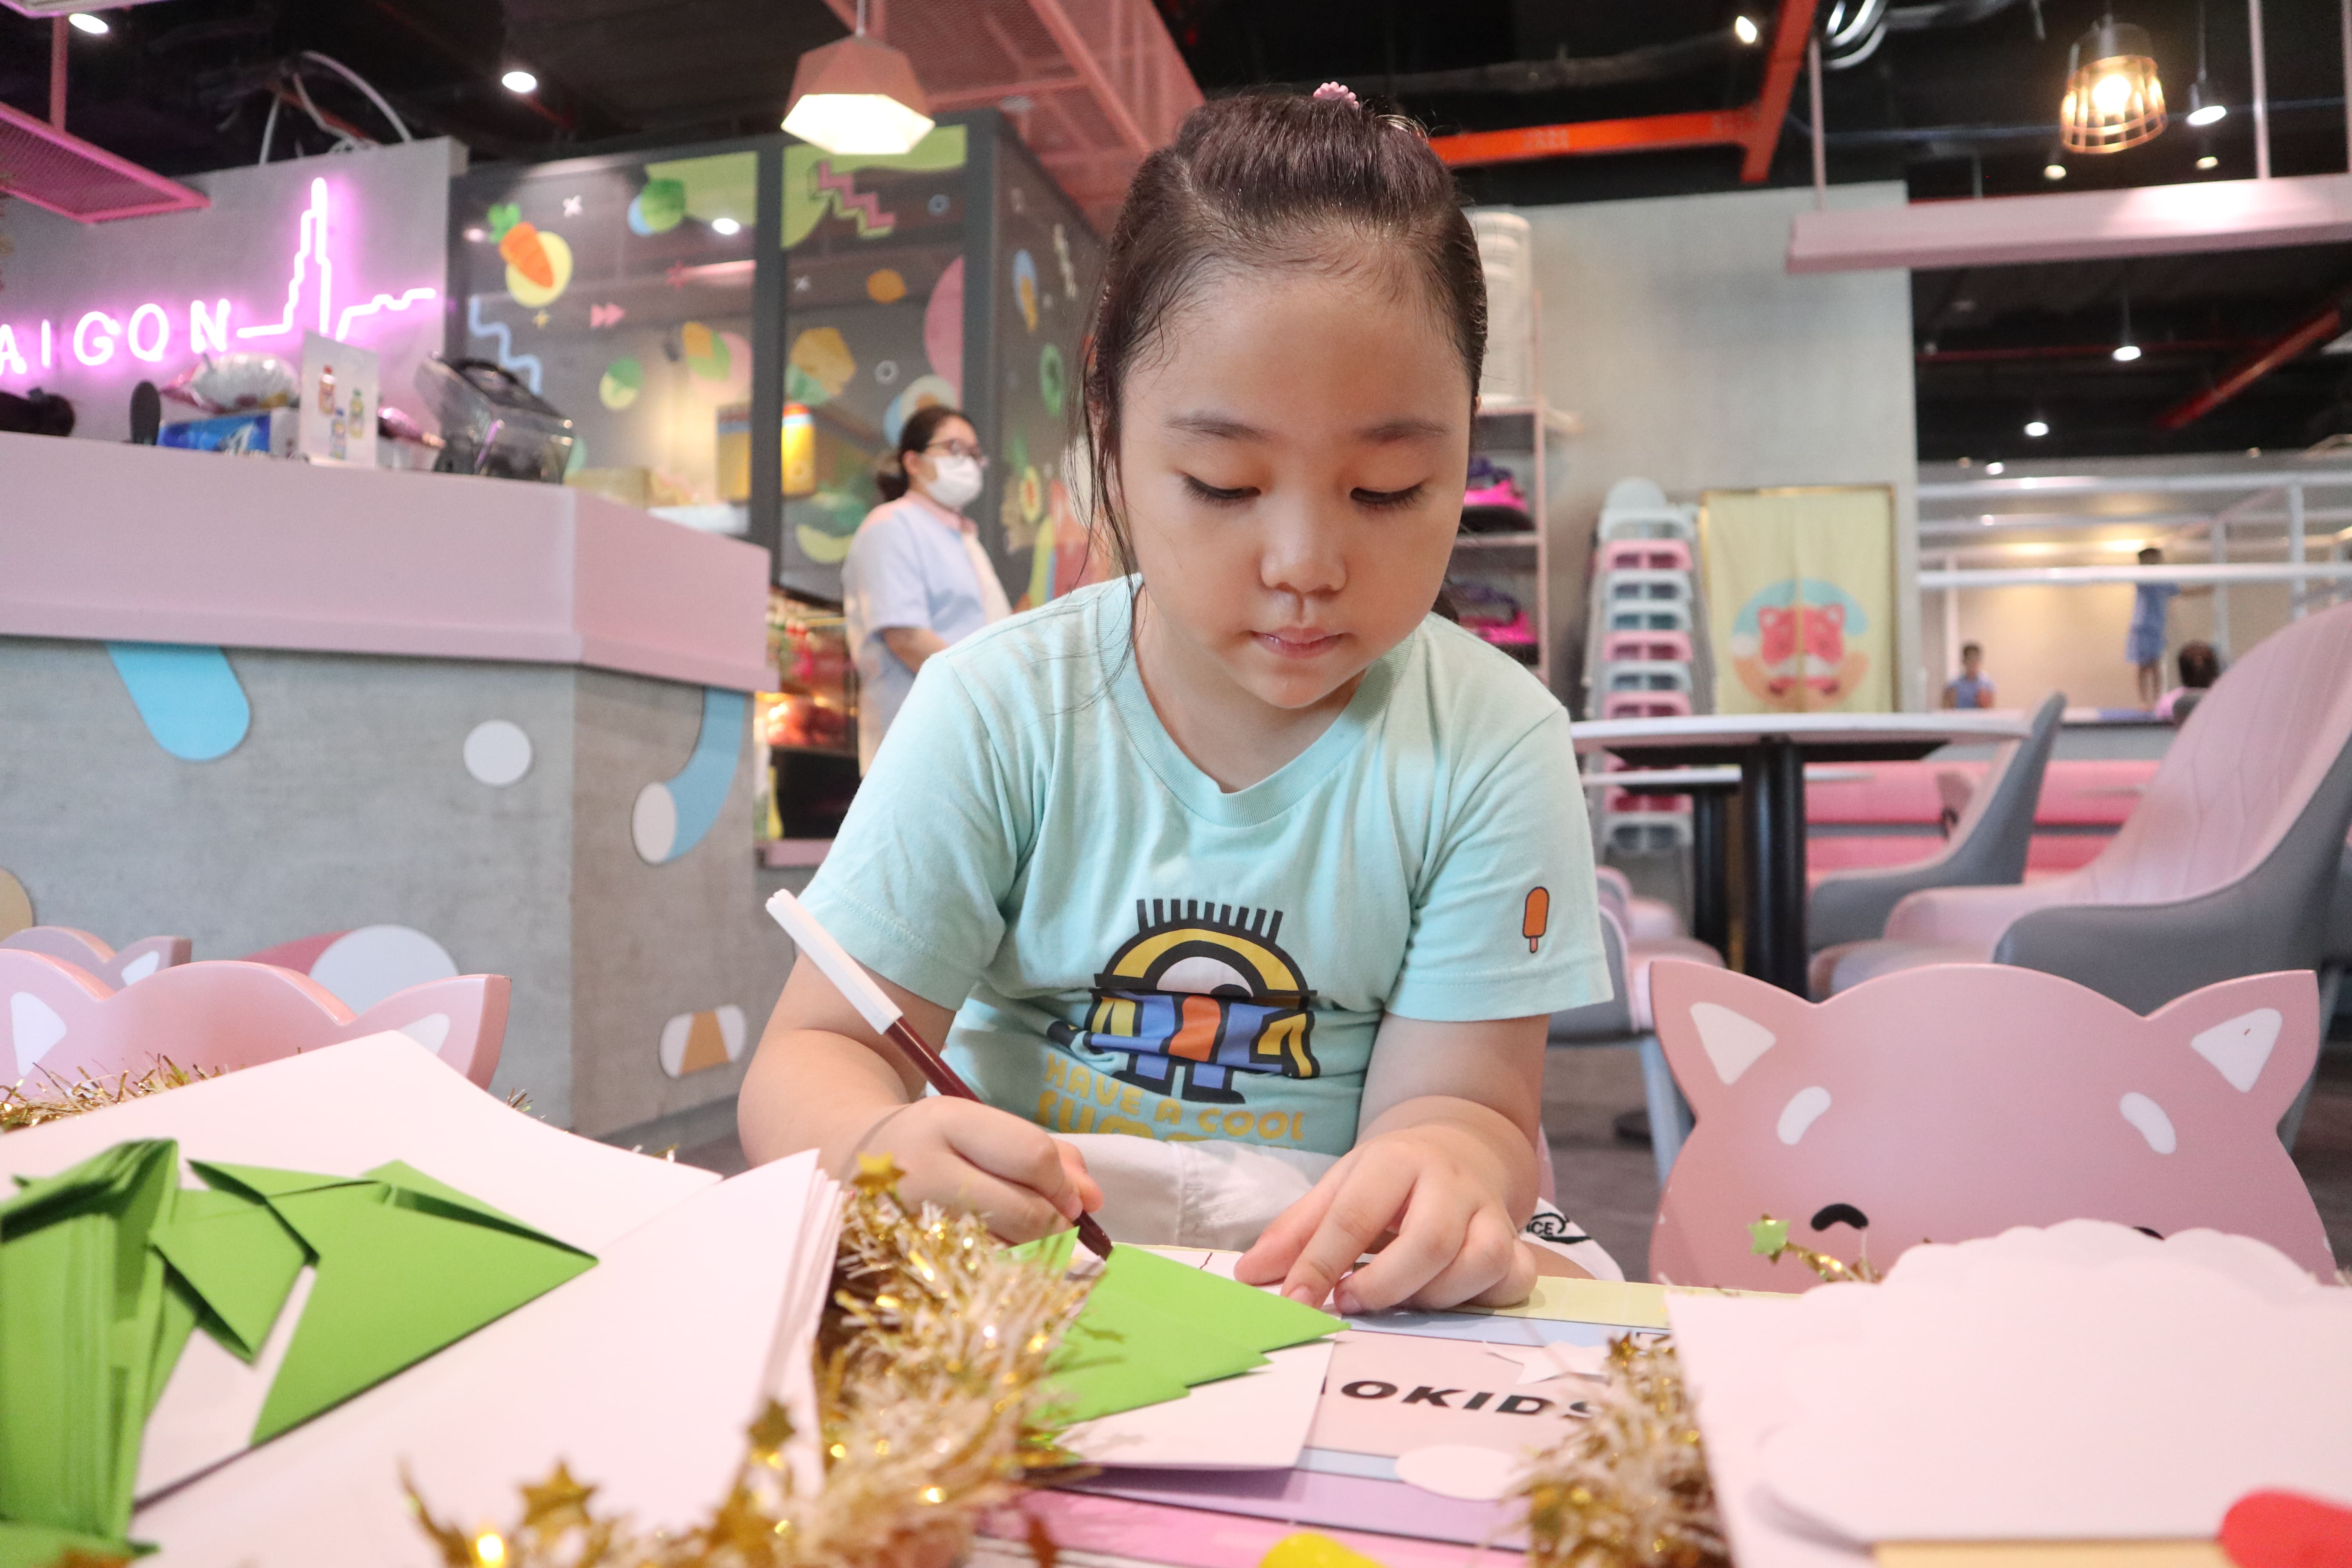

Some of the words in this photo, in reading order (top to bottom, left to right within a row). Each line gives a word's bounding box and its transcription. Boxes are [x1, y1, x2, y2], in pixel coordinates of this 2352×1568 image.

[1044, 1053, 1144, 1116] HAVE
[1154, 1098, 1182, 1125] A
[1197, 1107, 1305, 1141] COOL
